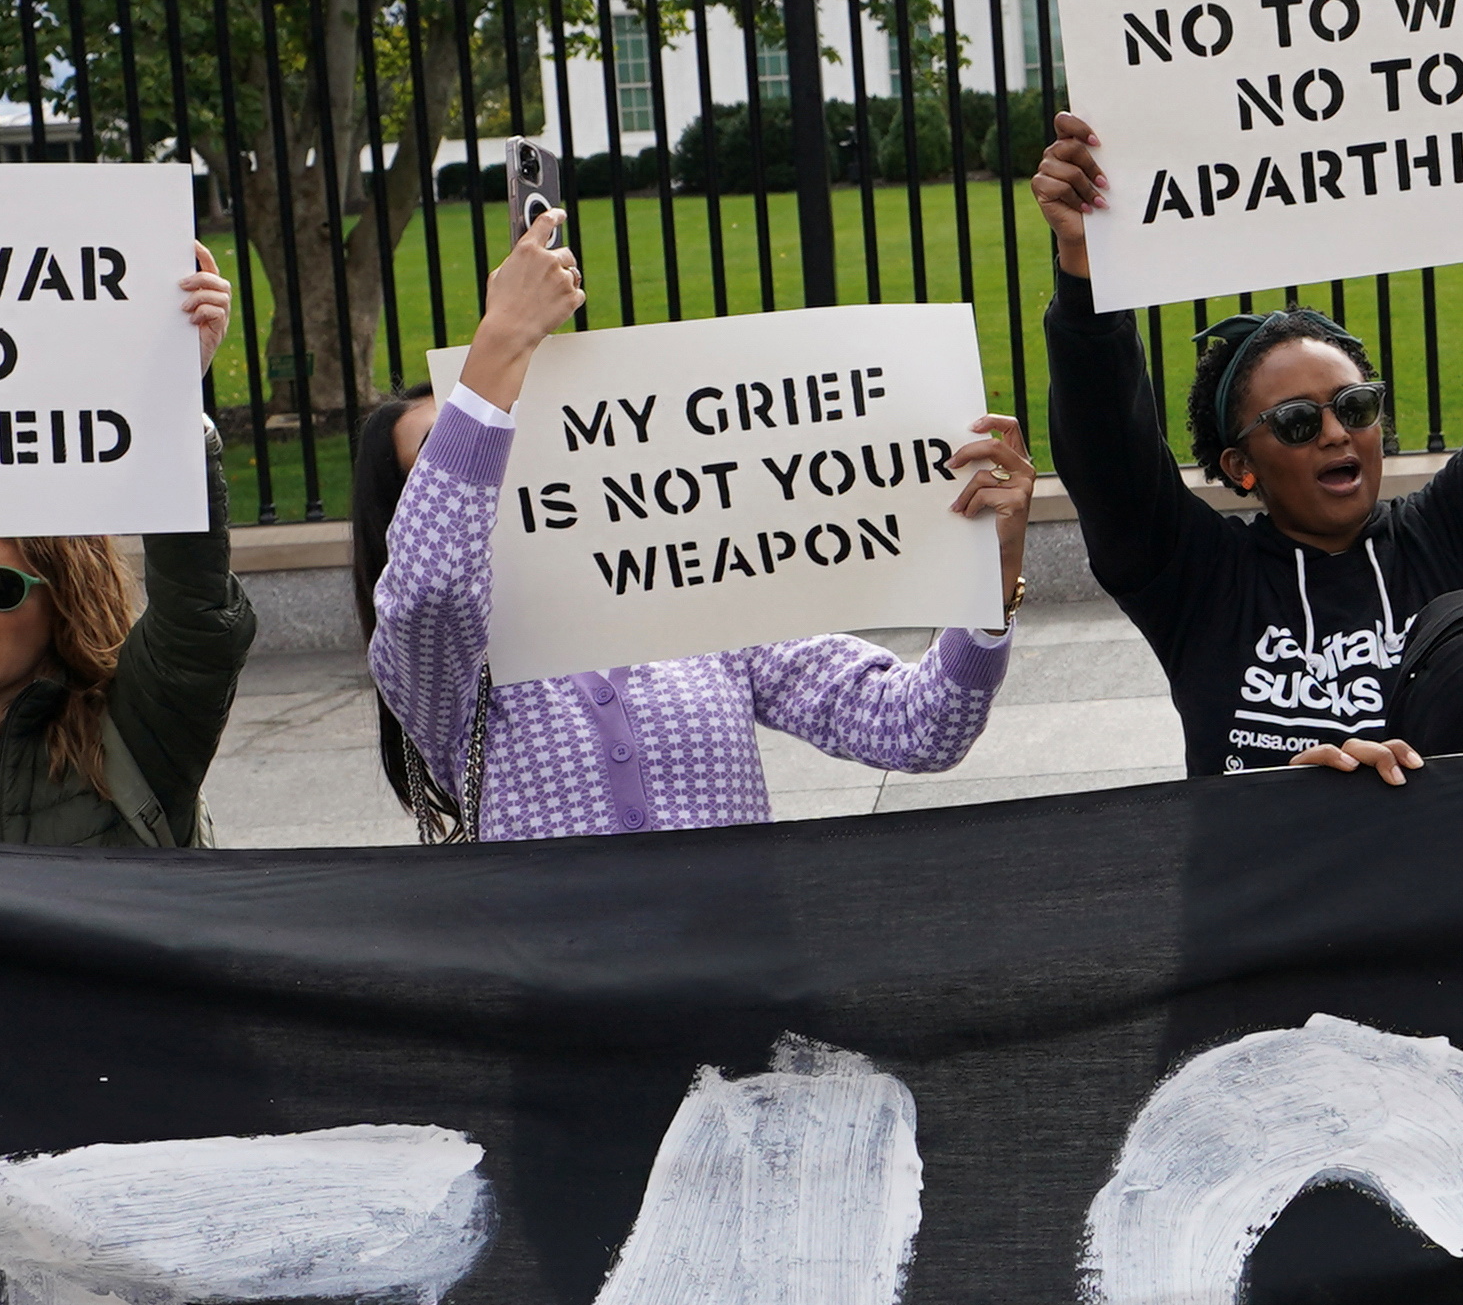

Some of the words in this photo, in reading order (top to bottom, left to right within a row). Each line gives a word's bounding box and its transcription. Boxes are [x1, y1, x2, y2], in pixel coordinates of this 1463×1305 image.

[1122, 2, 1235, 66] NO
[1235, 67, 1345, 131] NO
[561, 394, 657, 452] MY
[685, 367, 886, 436] GRIEF
[517, 482, 578, 533] IS
[601, 461, 739, 523] NOT
[761, 437, 957, 501] YOUR
[592, 513, 902, 595] WEAPON
